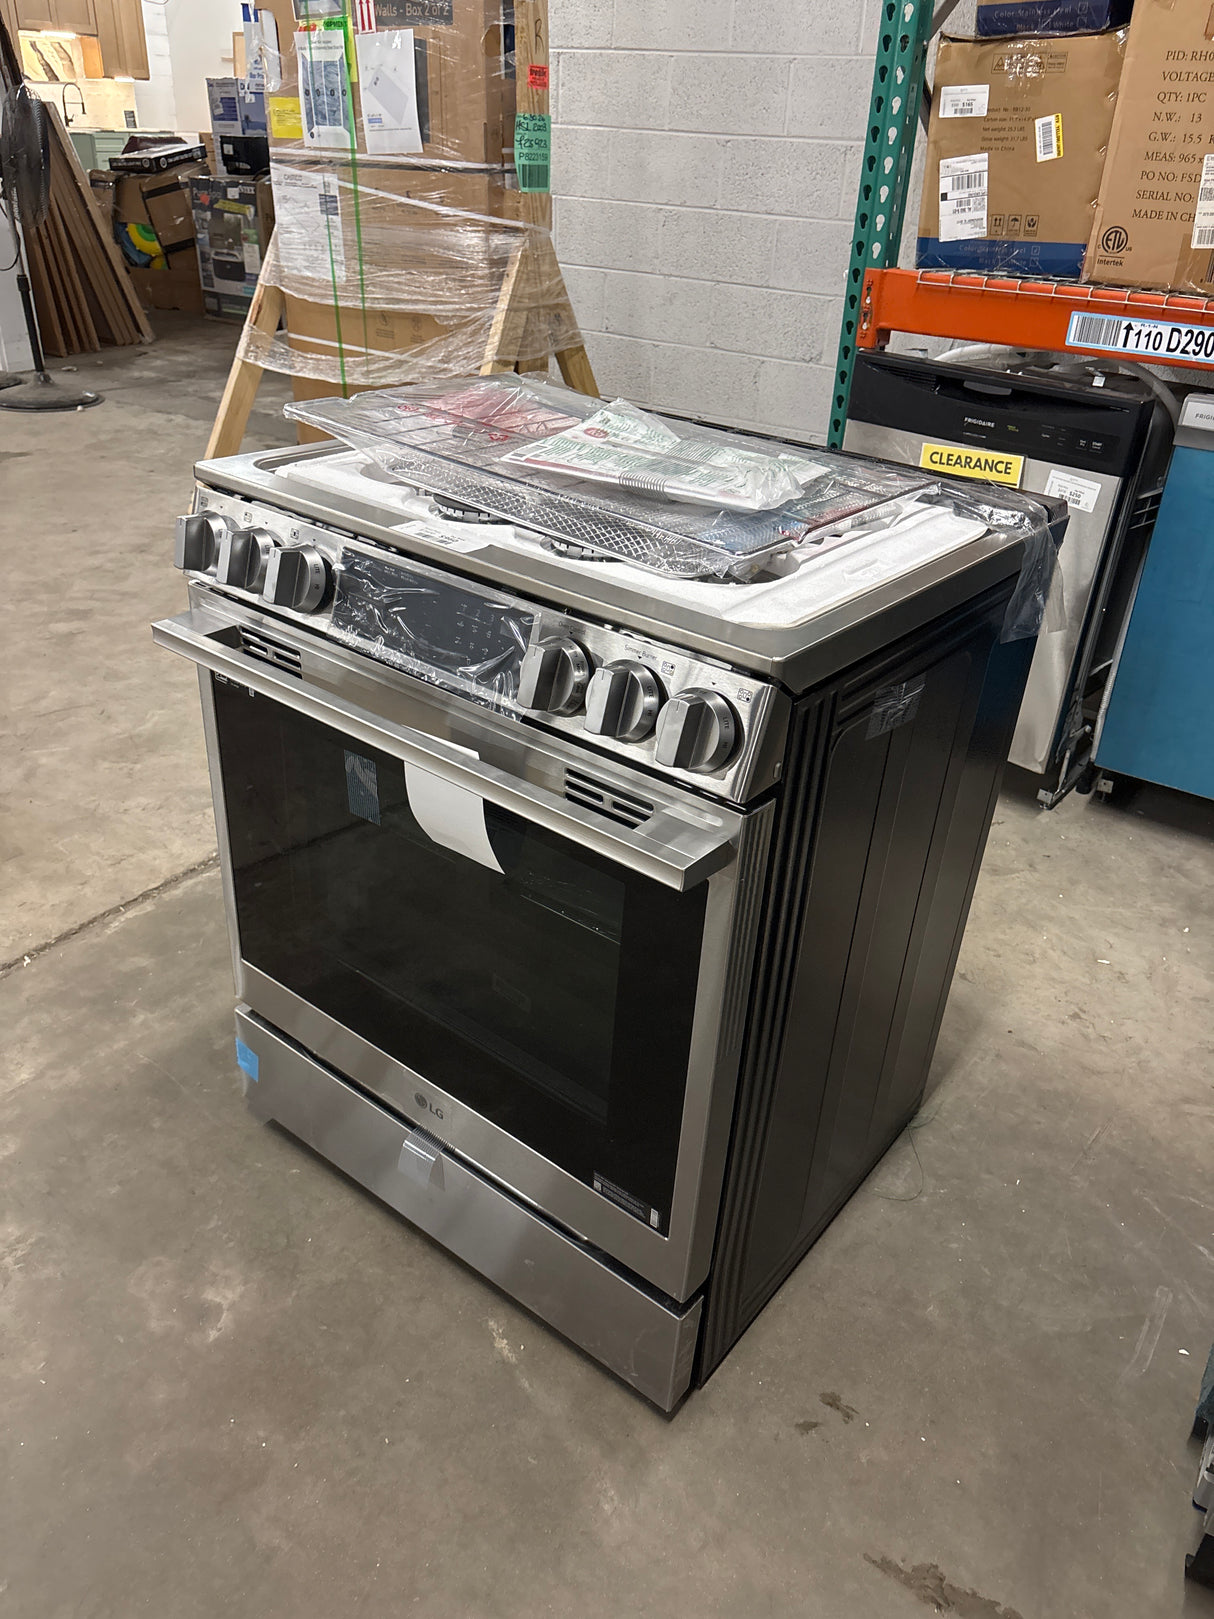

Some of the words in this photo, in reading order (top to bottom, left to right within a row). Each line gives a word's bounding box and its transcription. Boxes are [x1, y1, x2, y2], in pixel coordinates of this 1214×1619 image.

[375, 4, 398, 17] Walls
[405, 3, 423, 16] Box
[424, 4, 430, 16] 2
[432, 4, 441, 16] of
[443, 6, 450, 16] 2
[1166, 50, 1188, 61] PID:
[1161, 71, 1214, 82] VOLTAGE
[1157, 91, 1183, 104] QTY:
[1186, 92, 1207, 103] 1PC
[1152, 111, 1181, 123] N.W.:
[1190, 113, 1202, 124] 13
[1148, 131, 1176, 142] G.W.:
[1182, 133, 1203, 144] 15.5
[1144, 151, 1176, 162] MEAS:
[1178, 153, 1197, 163] 965
[1140, 170, 1156, 181] PO
[1157, 171, 1178, 182] NO:
[1135, 189, 1172, 202] SERIAL
[1173, 192, 1195, 203] NO:
[1132, 208, 1164, 220] MADE
[1165, 211, 1179, 221] IN
[1096, 258, 1124, 267] Intertek
[1134, 329, 1164, 351] 110
[964, 416, 996, 429] FRIGIDAIRE
[1195, 412, 1214, 421] FRIGI
[929, 450, 1013, 475] CLEARANCE
[313, 563, 321, 575] LITE
[624, 643, 641, 655] Simmer
[641, 650, 658, 661] Burner
[722, 716, 730, 730] LITE
[429, 1102, 444, 1120] LG
